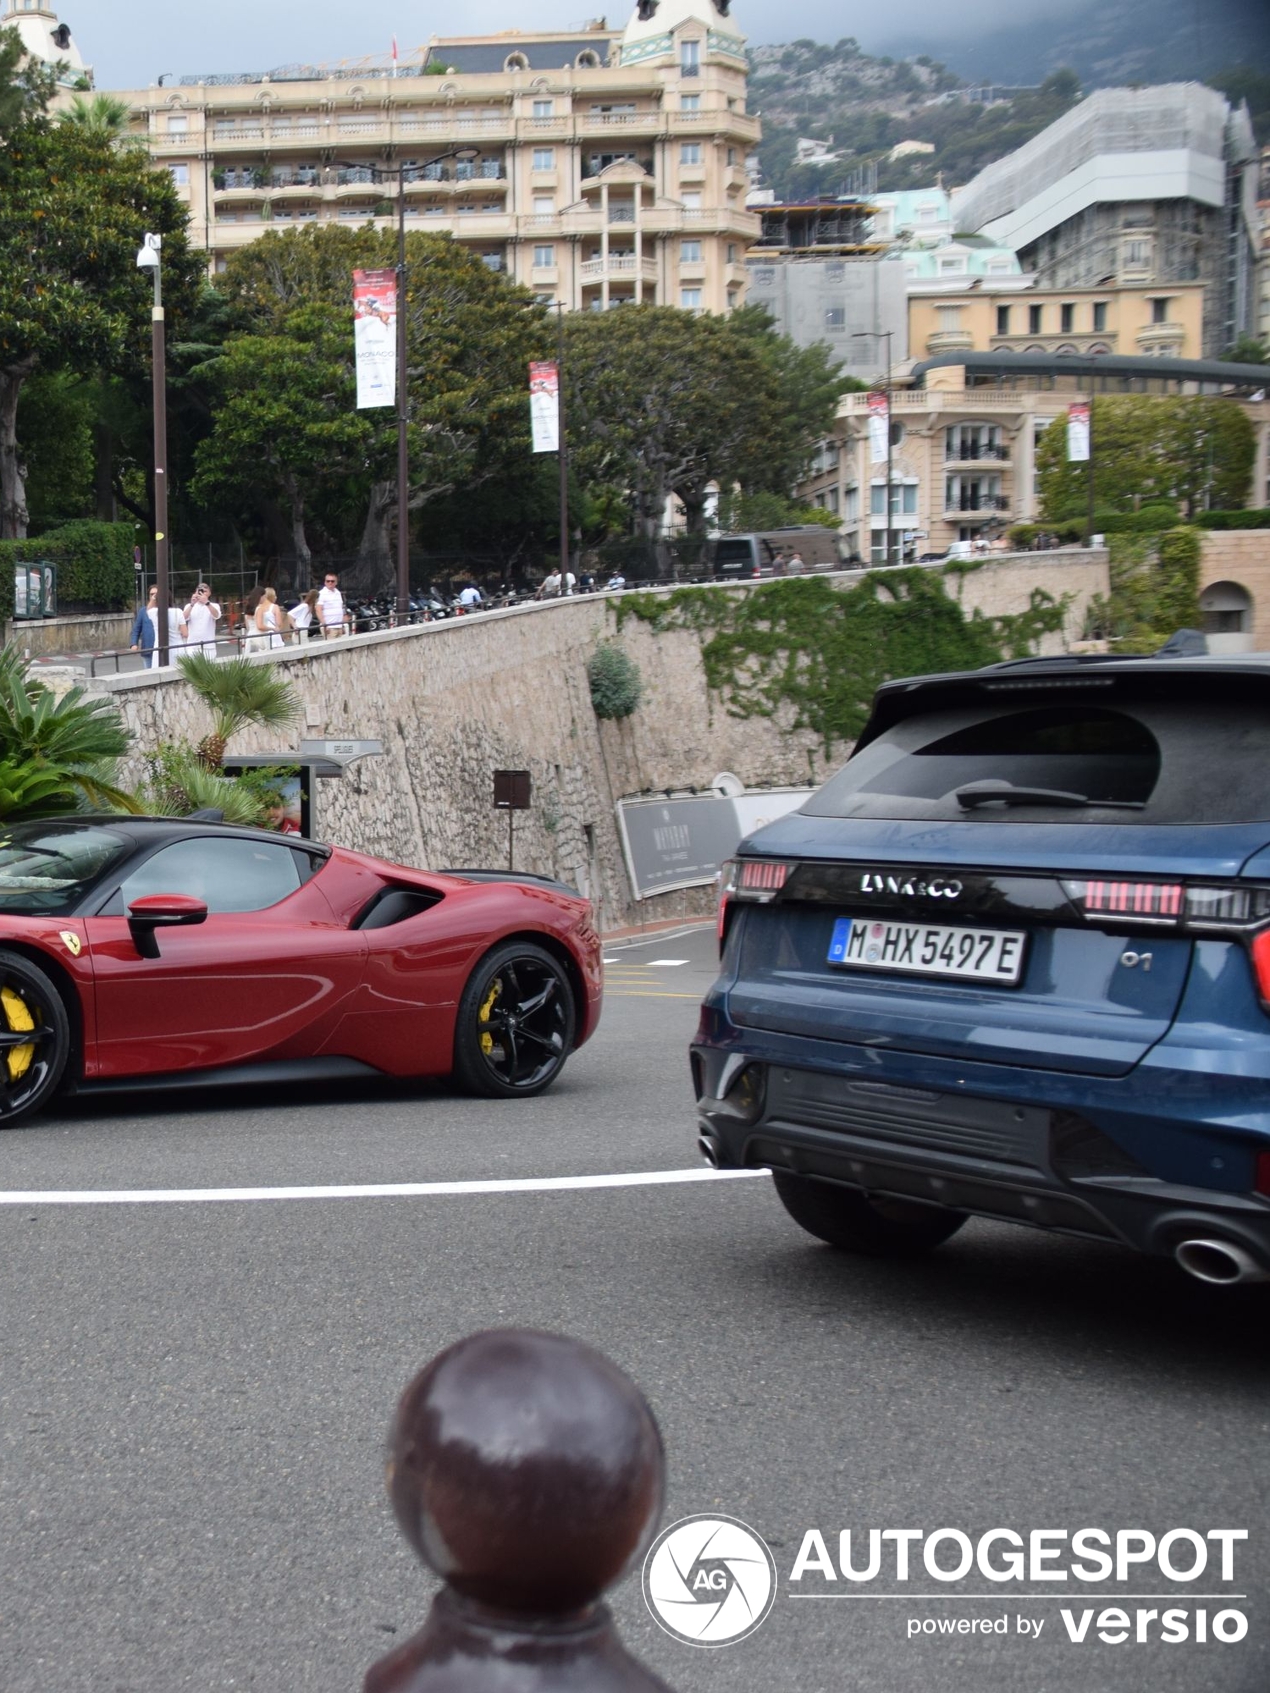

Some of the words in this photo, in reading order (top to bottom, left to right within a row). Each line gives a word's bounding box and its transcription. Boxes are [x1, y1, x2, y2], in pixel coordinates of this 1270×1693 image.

[357, 350, 395, 359] MONACO
[847, 923, 868, 959] M
[1121, 951, 1153, 972] 01
